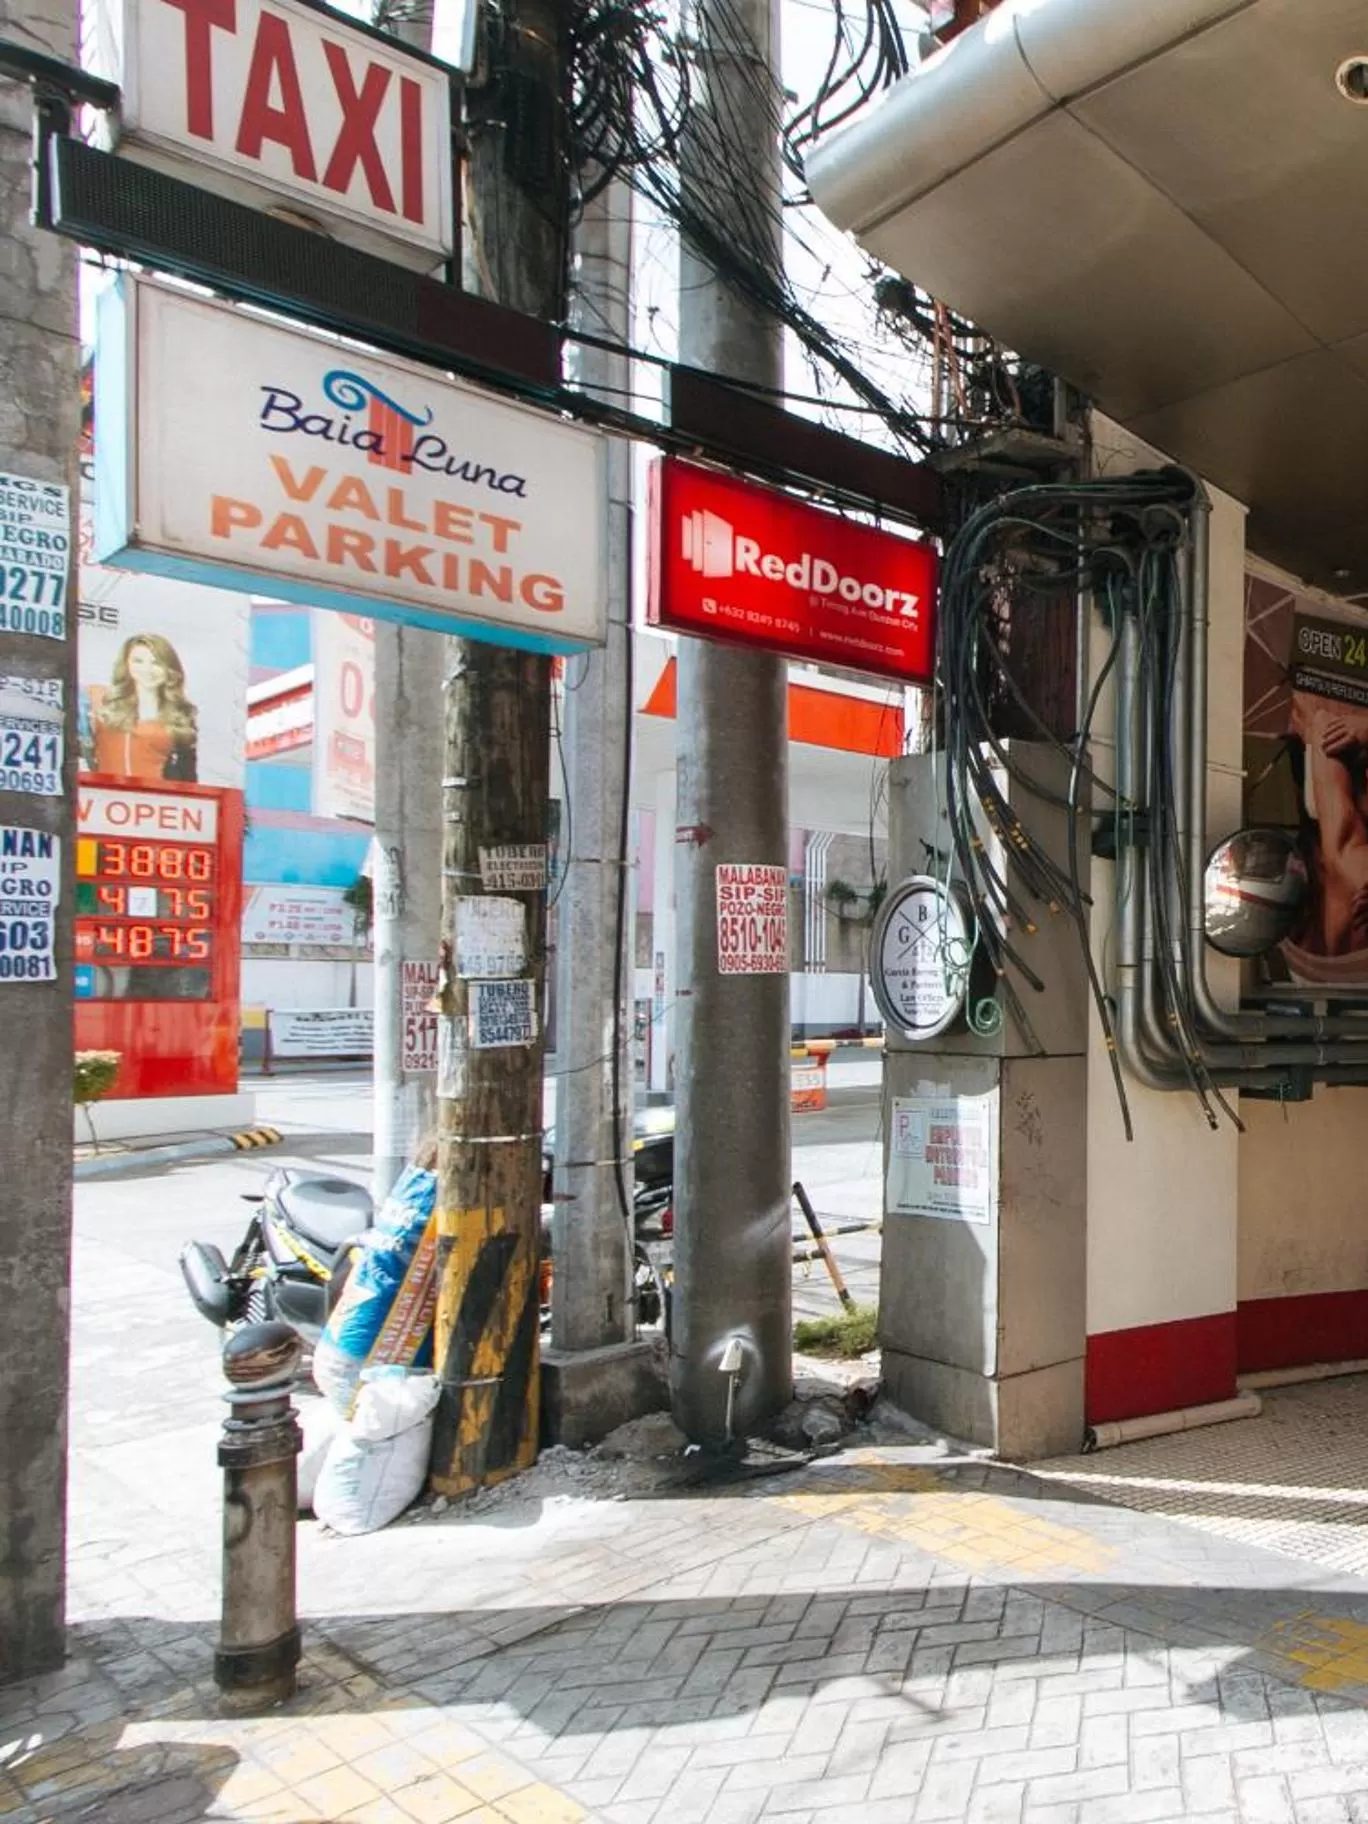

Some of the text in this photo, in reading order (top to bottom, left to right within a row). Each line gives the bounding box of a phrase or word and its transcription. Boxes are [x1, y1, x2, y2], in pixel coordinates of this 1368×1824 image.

[156, 0, 425, 225] TAXI
[260, 385, 528, 498] Baia Luna
[269, 453, 521, 554] VALET
[210, 495, 565, 612] PARKING
[735, 535, 919, 618] RedDoorz
[1298, 627, 1343, 661] OPEN
[1344, 634, 1367, 668] 24
[106, 800, 202, 833] OPEN
[104, 843, 211, 880] 3880
[919, 904, 927, 923] B
[97, 926, 210, 960] 4875
[898, 926, 909, 945] G
